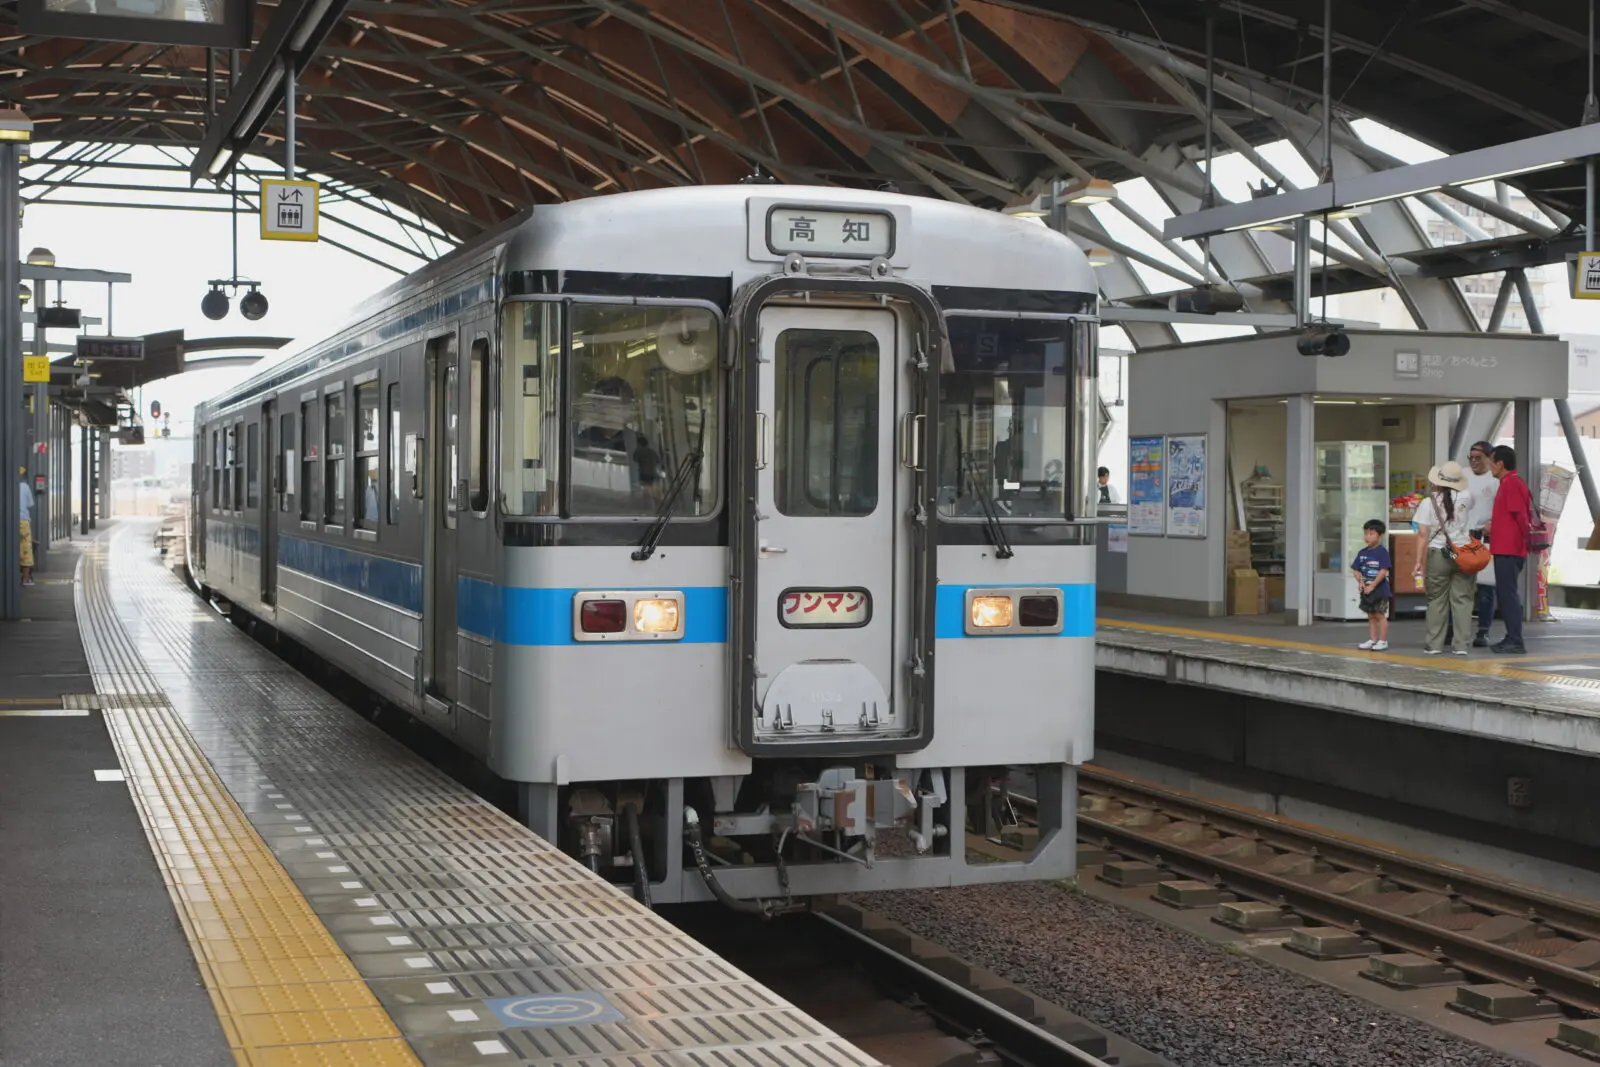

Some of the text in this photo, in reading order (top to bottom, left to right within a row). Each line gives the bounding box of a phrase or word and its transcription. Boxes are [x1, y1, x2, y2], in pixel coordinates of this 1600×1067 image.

[788, 216, 870, 243] 高知
[783, 593, 863, 613] ワンマン
